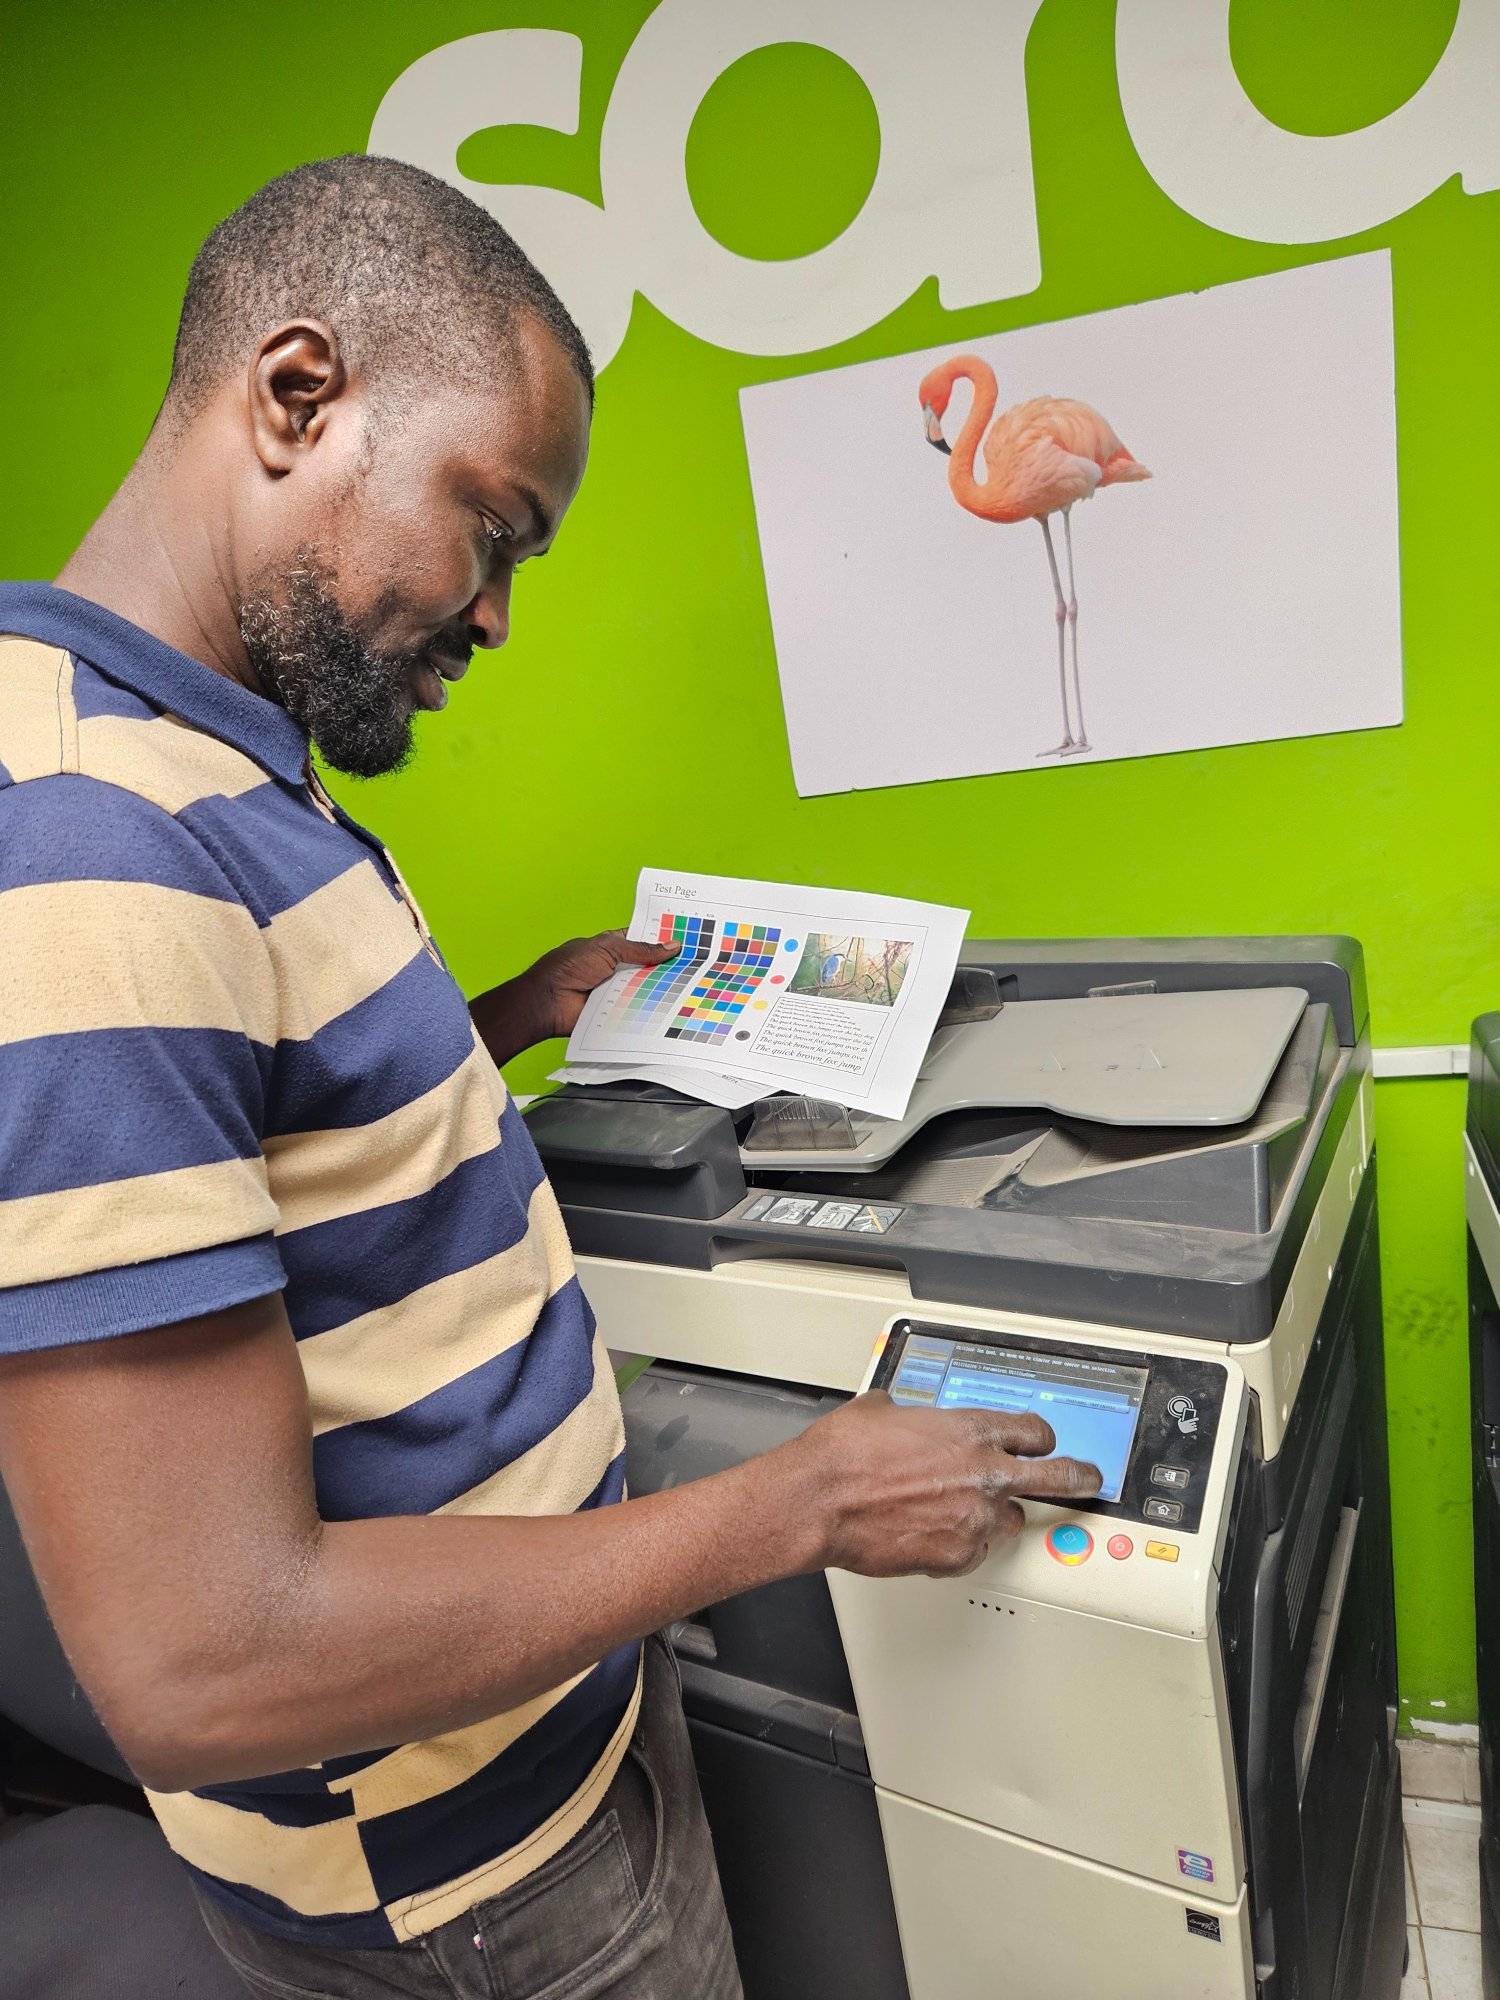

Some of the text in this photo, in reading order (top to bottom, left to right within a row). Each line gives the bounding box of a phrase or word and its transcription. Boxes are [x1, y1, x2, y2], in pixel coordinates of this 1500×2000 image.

[654, 882, 697, 898] Test Page
[793, 1034, 813, 1042] brown
[813, 1037, 824, 1045] fox
[823, 1040, 844, 1048] jumps
[755, 1043, 862, 1072] The quick brown fox jump
[793, 1041, 816, 1051] brown
[813, 1045, 828, 1053] fox
[828, 1049, 851, 1059] jumps
[851, 1053, 865, 1061] ove
